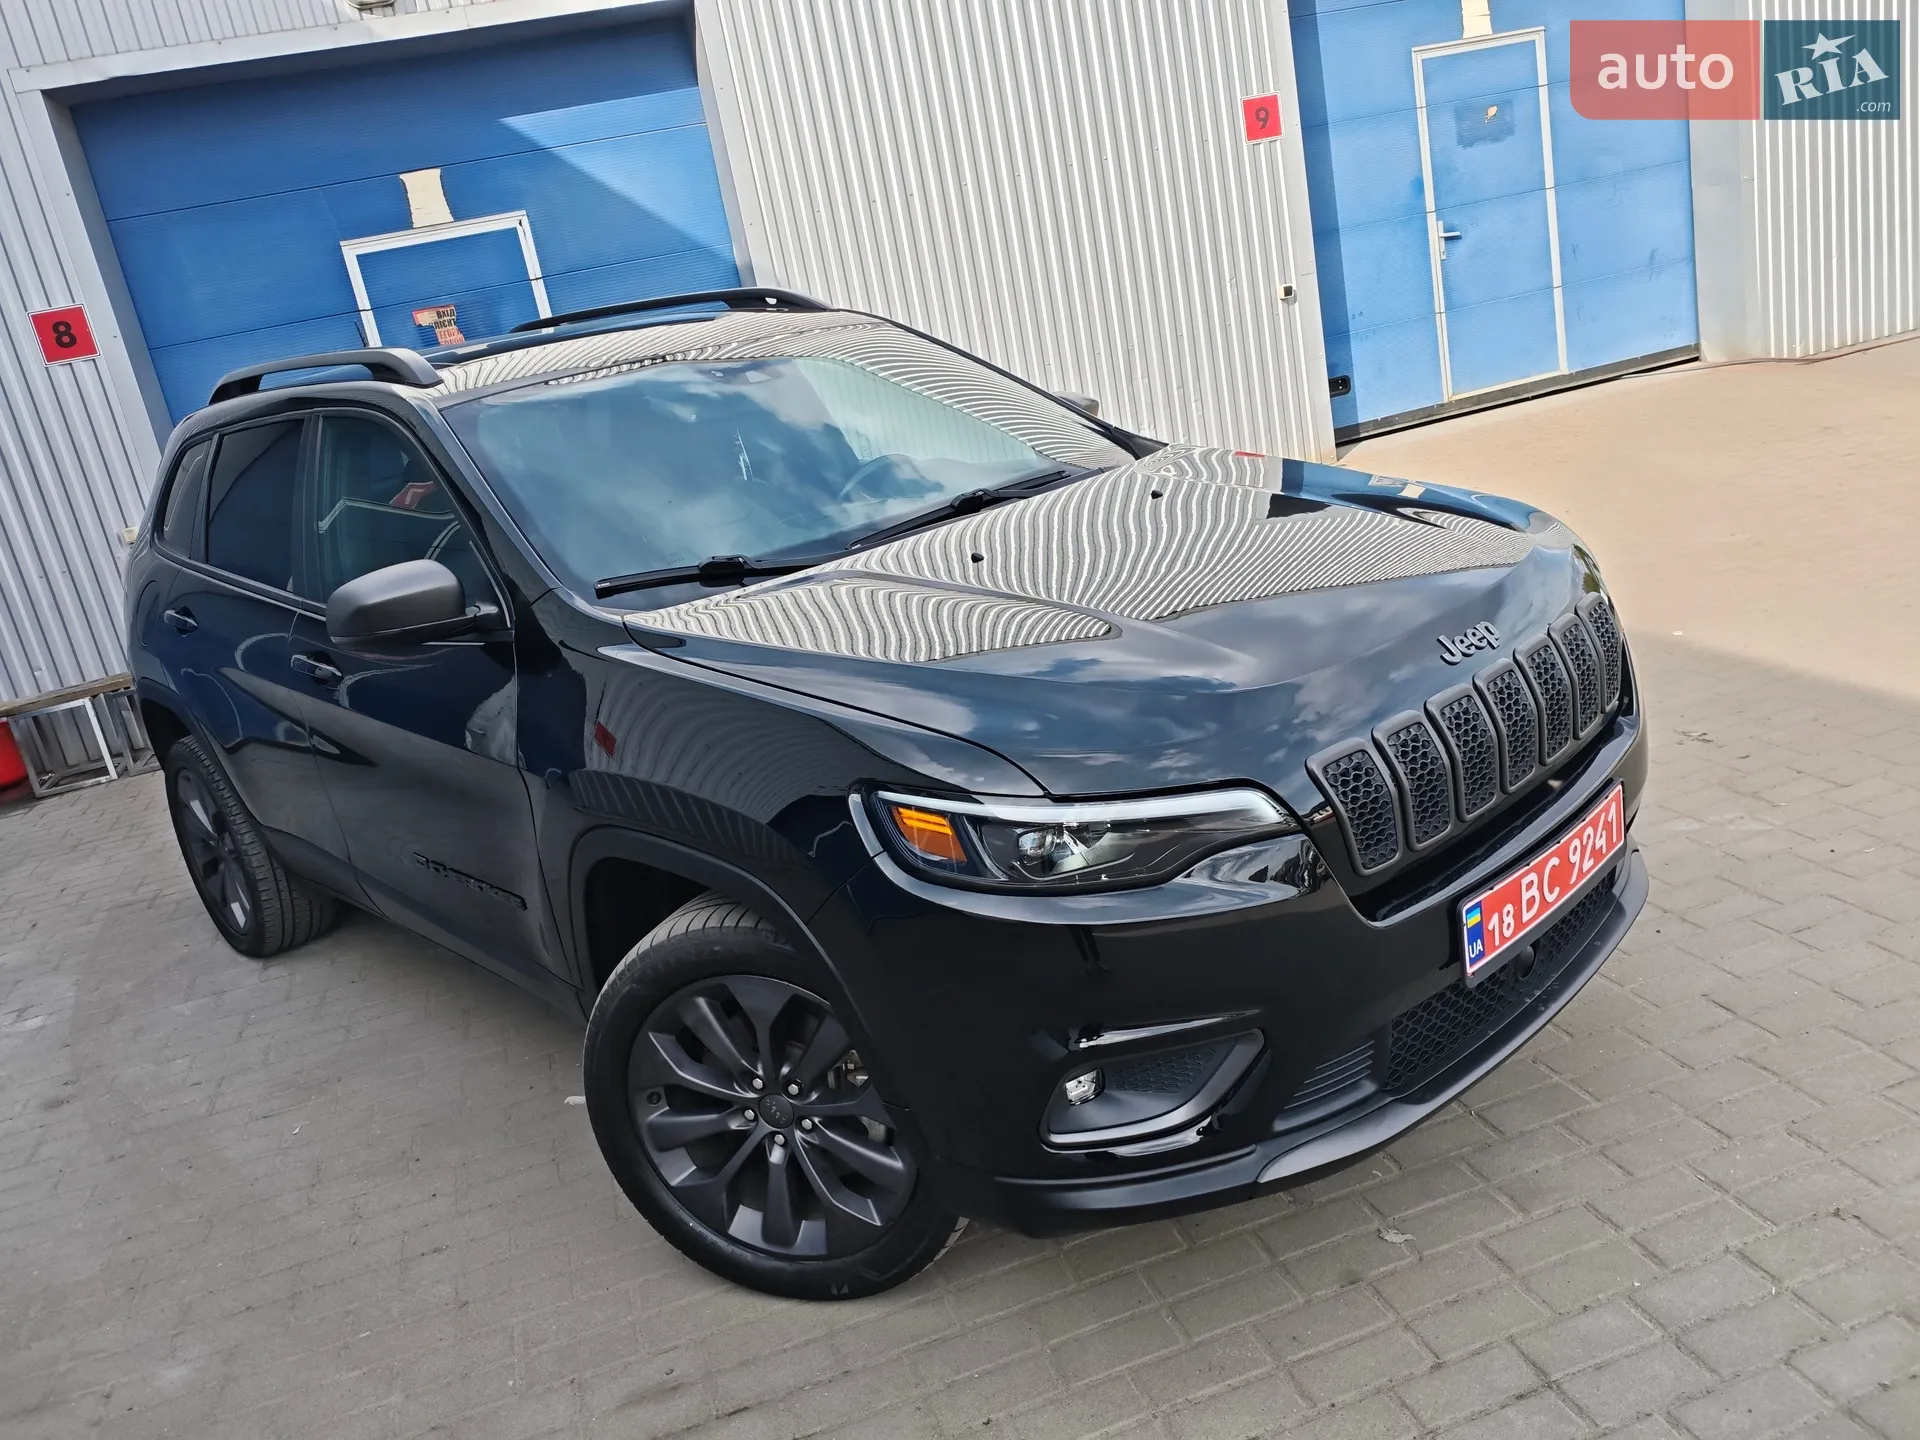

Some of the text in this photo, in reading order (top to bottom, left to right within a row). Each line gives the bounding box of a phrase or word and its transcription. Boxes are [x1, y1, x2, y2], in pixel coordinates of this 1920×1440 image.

[1255, 106, 1270, 130] 9
[436, 308, 456, 319] ВХІД
[52, 320, 78, 349] 8
[1436, 620, 1501, 666] Jeep
[1487, 801, 1617, 947] 18 BC 9241
[1469, 939, 1484, 959] UA
